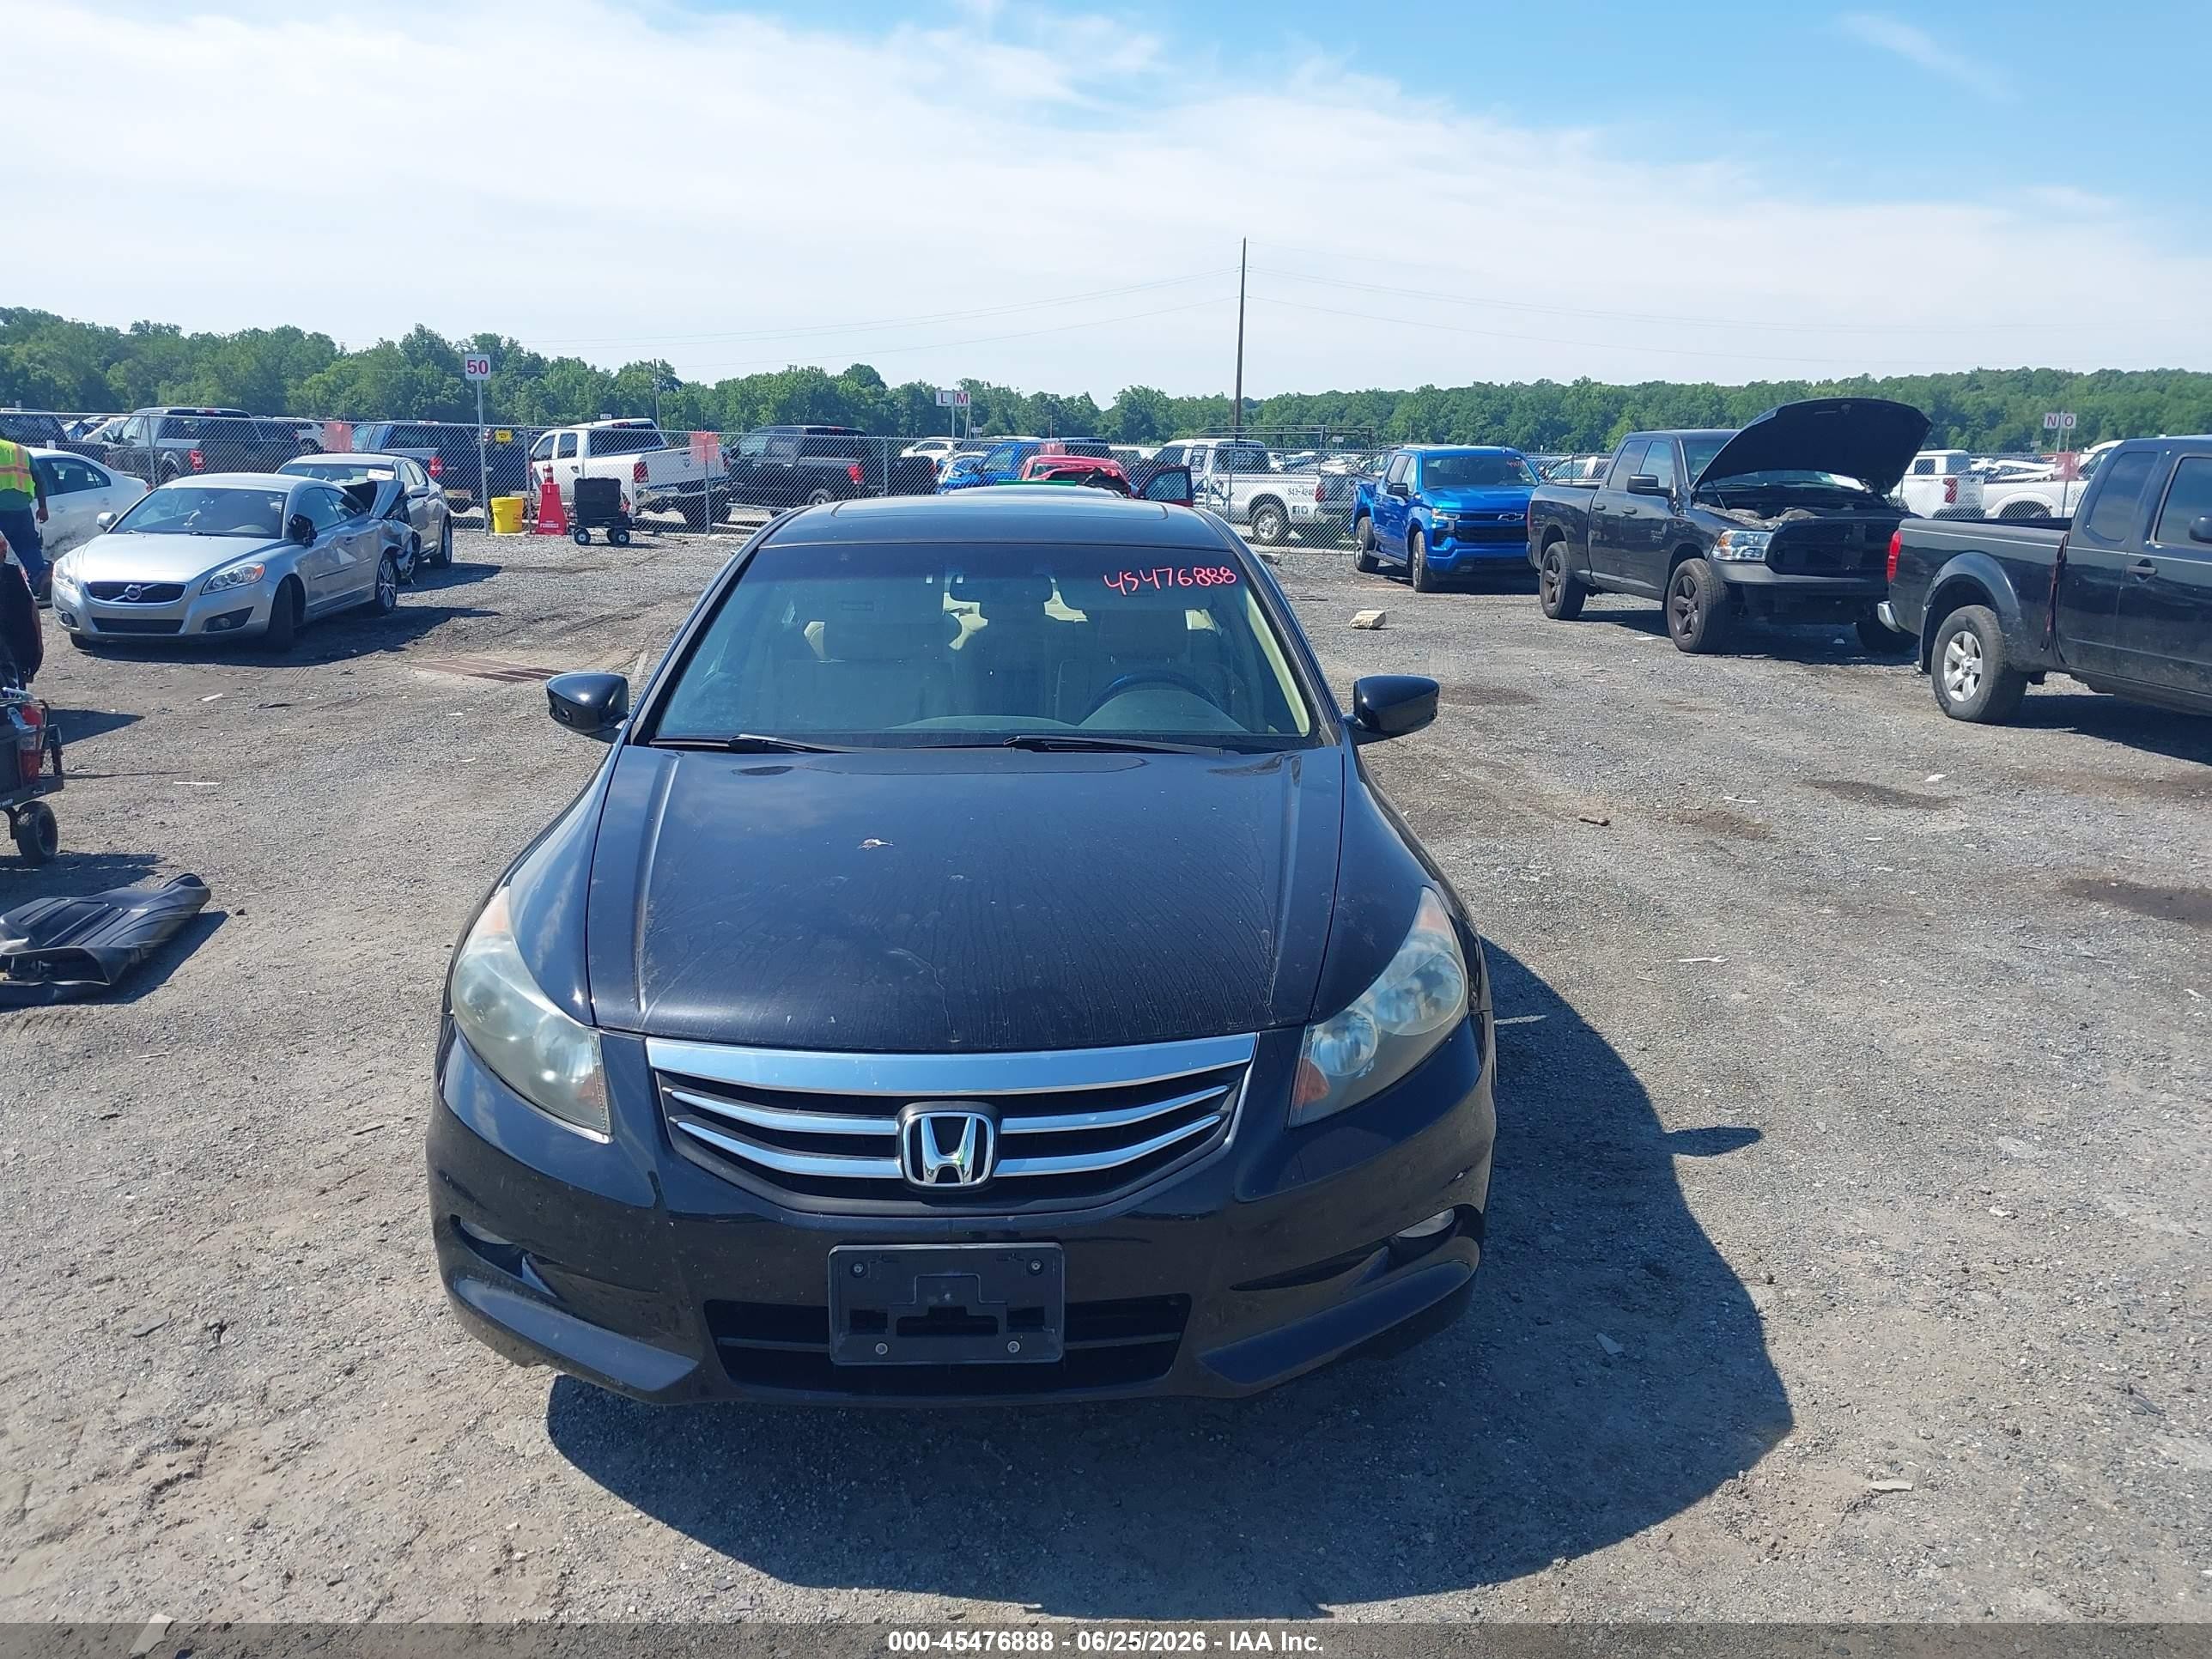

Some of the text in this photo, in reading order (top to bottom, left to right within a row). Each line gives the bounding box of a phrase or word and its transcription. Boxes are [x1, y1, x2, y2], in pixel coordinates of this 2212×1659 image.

[466, 359, 489, 374] 50
[940, 392, 948, 404] L
[957, 392, 969, 404] M
[2046, 416, 2057, 427] N
[1103, 565, 1237, 597] 45476888
